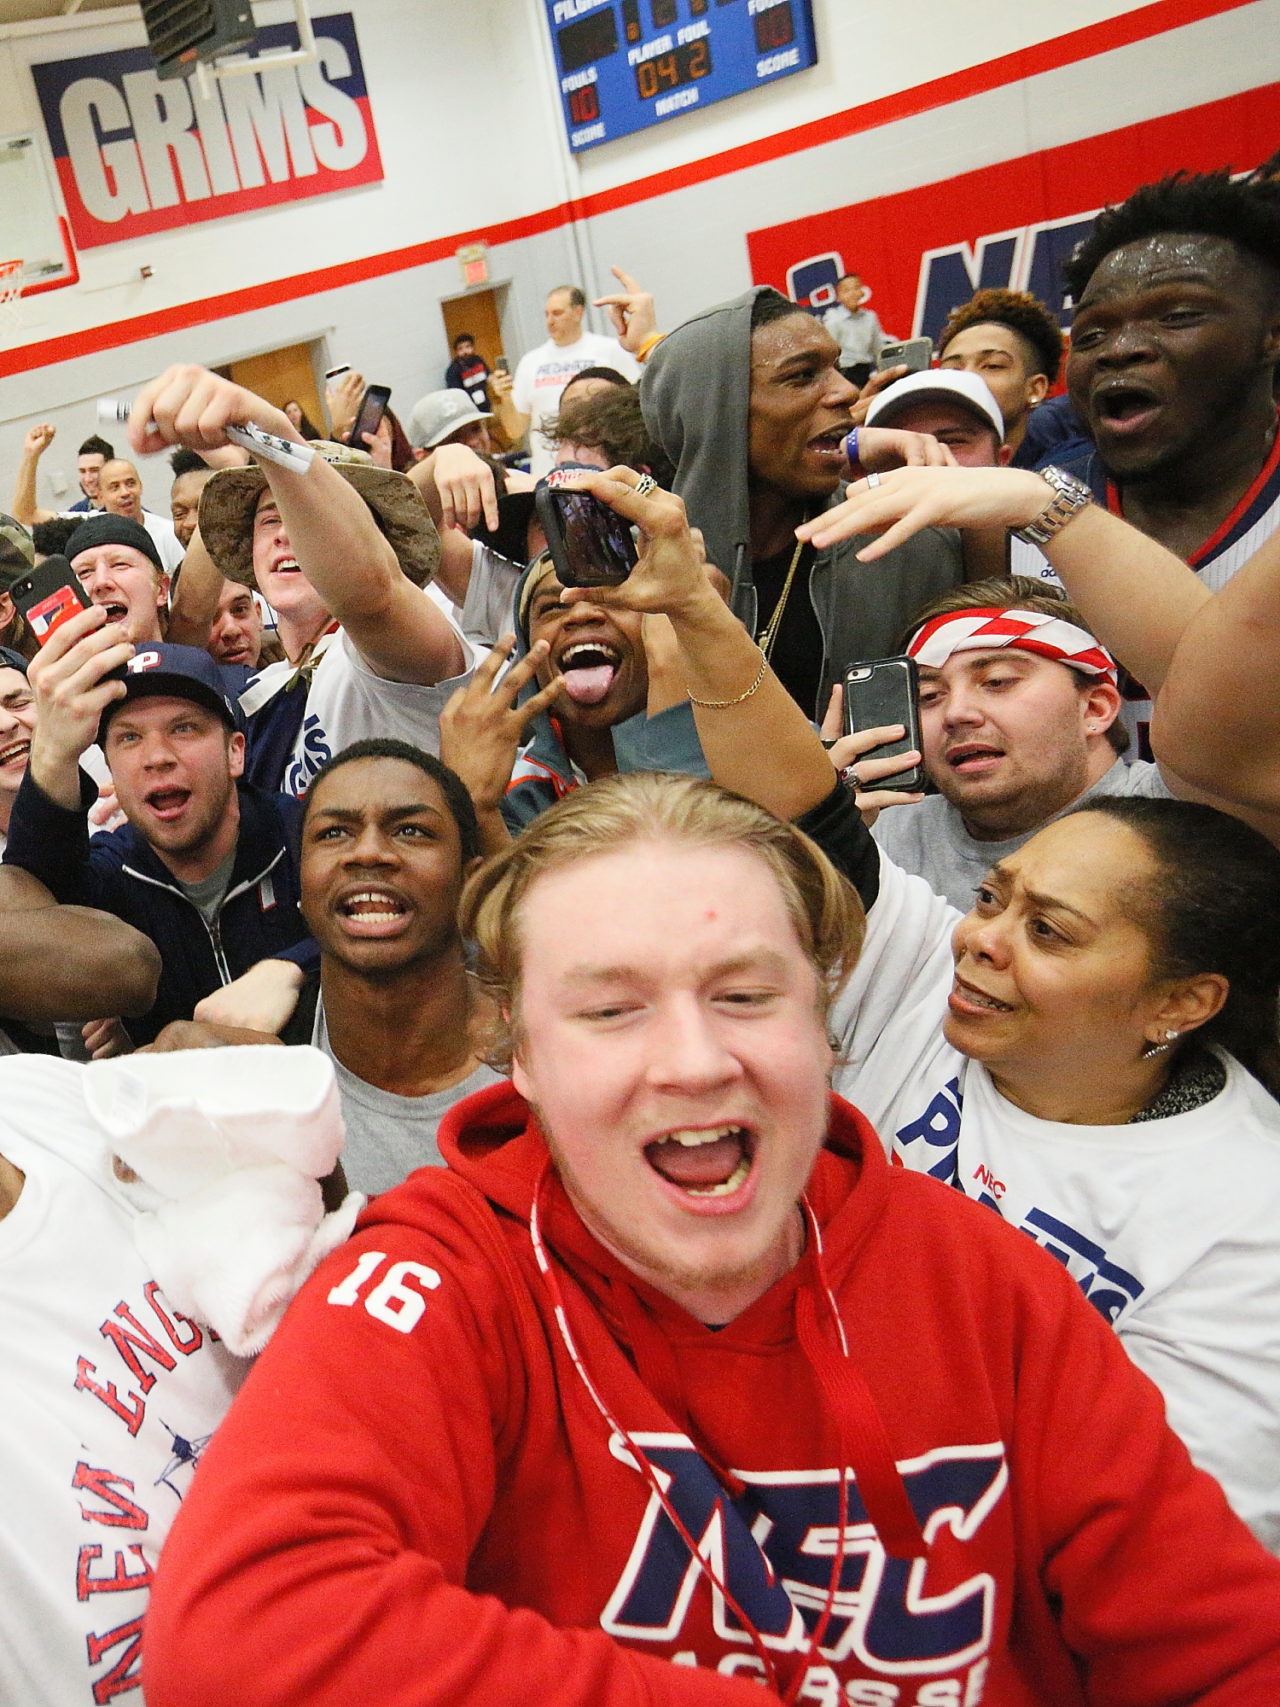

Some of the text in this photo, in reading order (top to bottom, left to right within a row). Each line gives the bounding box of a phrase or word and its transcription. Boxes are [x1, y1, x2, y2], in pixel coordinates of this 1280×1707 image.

[627, 19, 711, 66] PLAYER FOUL
[756, 47, 800, 77] SCORE
[561, 66, 598, 93] FOULS
[655, 87, 699, 116] MATCH
[60, 37, 368, 223] GRIMS
[571, 122, 605, 147] SCORE
[127, 651, 161, 673] P
[972, 1164, 1006, 1199] NEC
[327, 1251, 441, 1334] 16
[600, 1432, 1009, 1675] NEC
